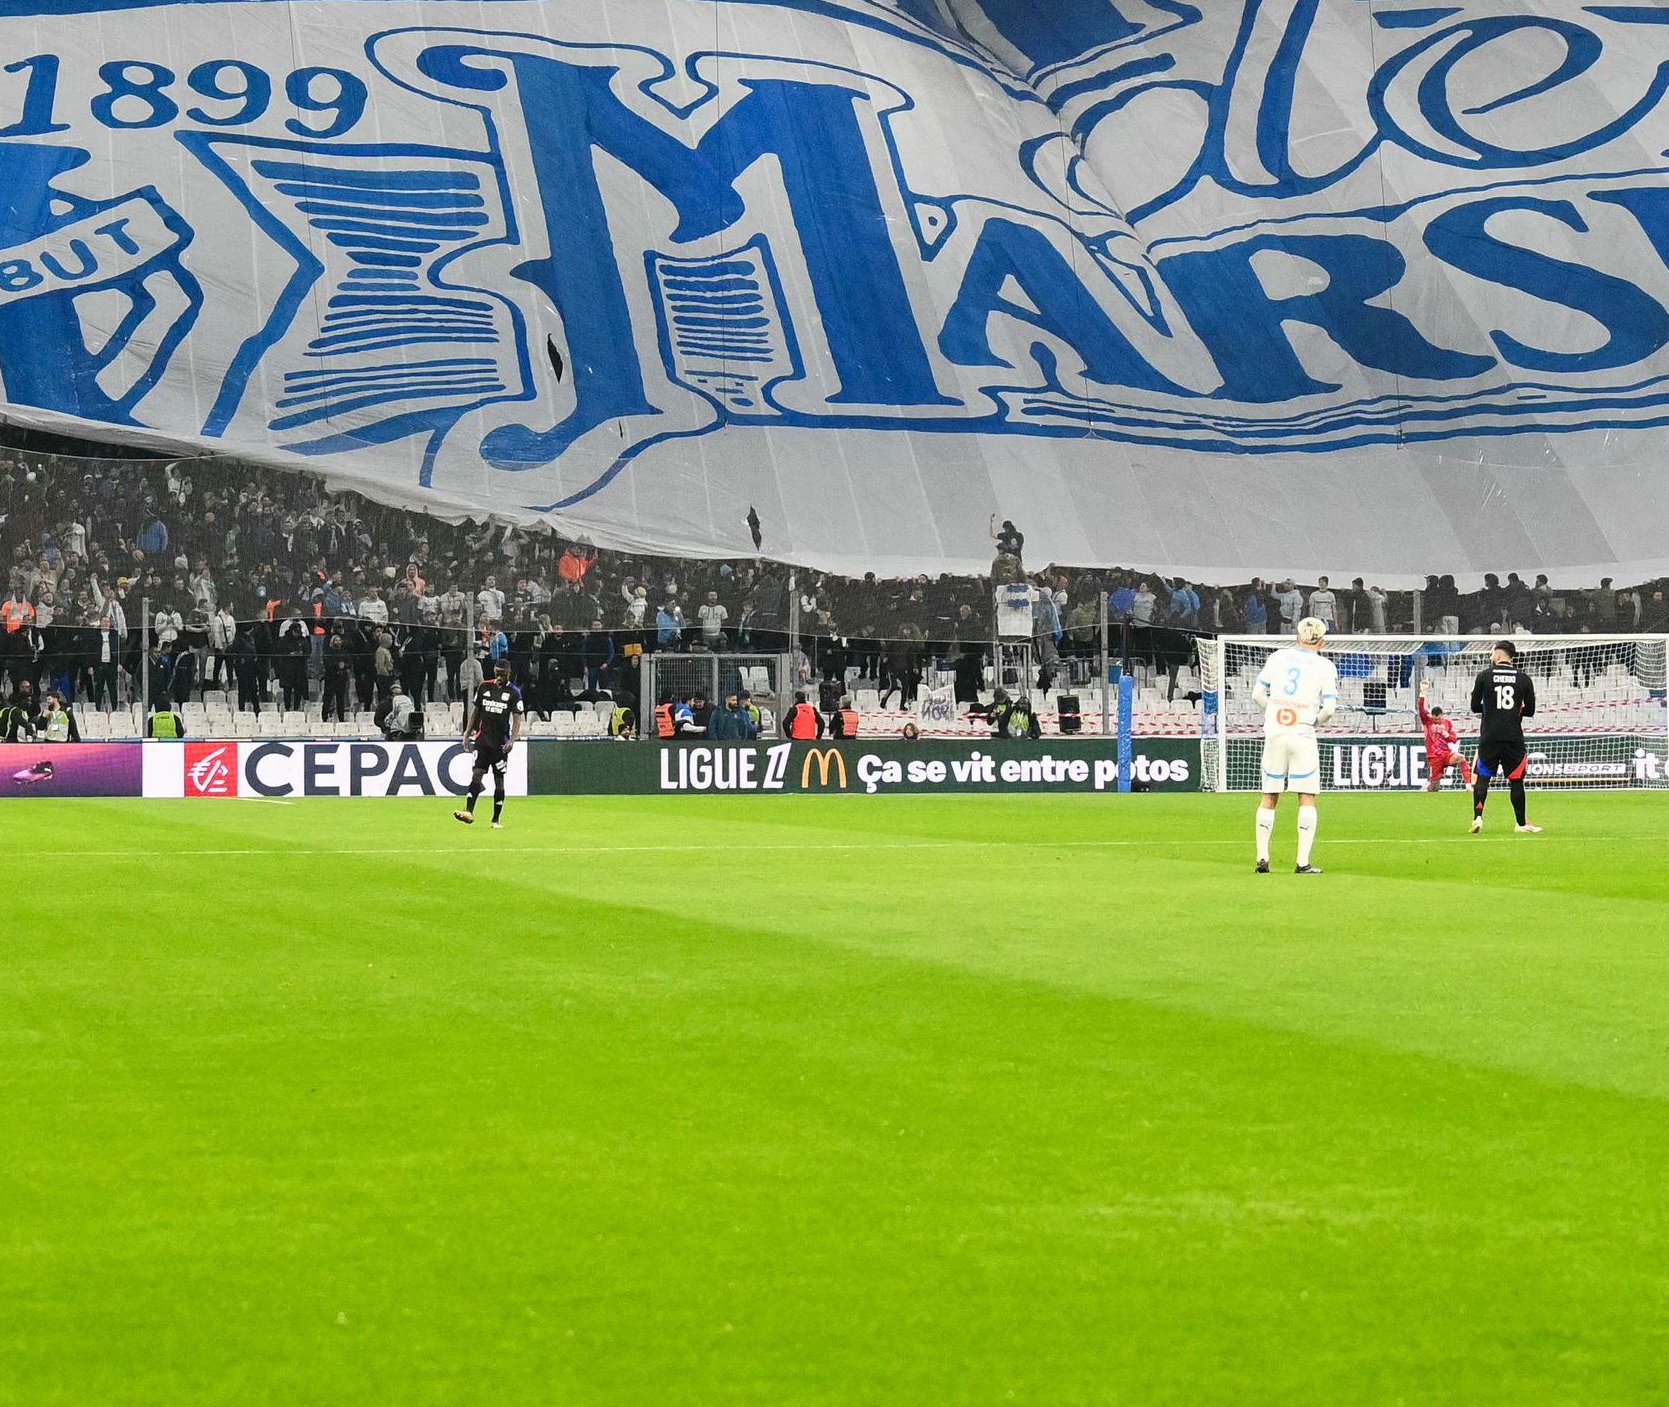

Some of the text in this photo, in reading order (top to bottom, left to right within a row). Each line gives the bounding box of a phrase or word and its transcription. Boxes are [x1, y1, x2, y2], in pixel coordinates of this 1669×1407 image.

[1284, 667, 1300, 695] 3
[1494, 685, 1515, 710] 18
[245, 742, 486, 797] CEPAC
[661, 748, 758, 789] LIGUE
[857, 754, 902, 793] Ça
[907, 760, 947, 783] se
[951, 751, 996, 783] vit
[1001, 755, 1089, 783] entre
[1333, 745, 1428, 786] LIGUE
